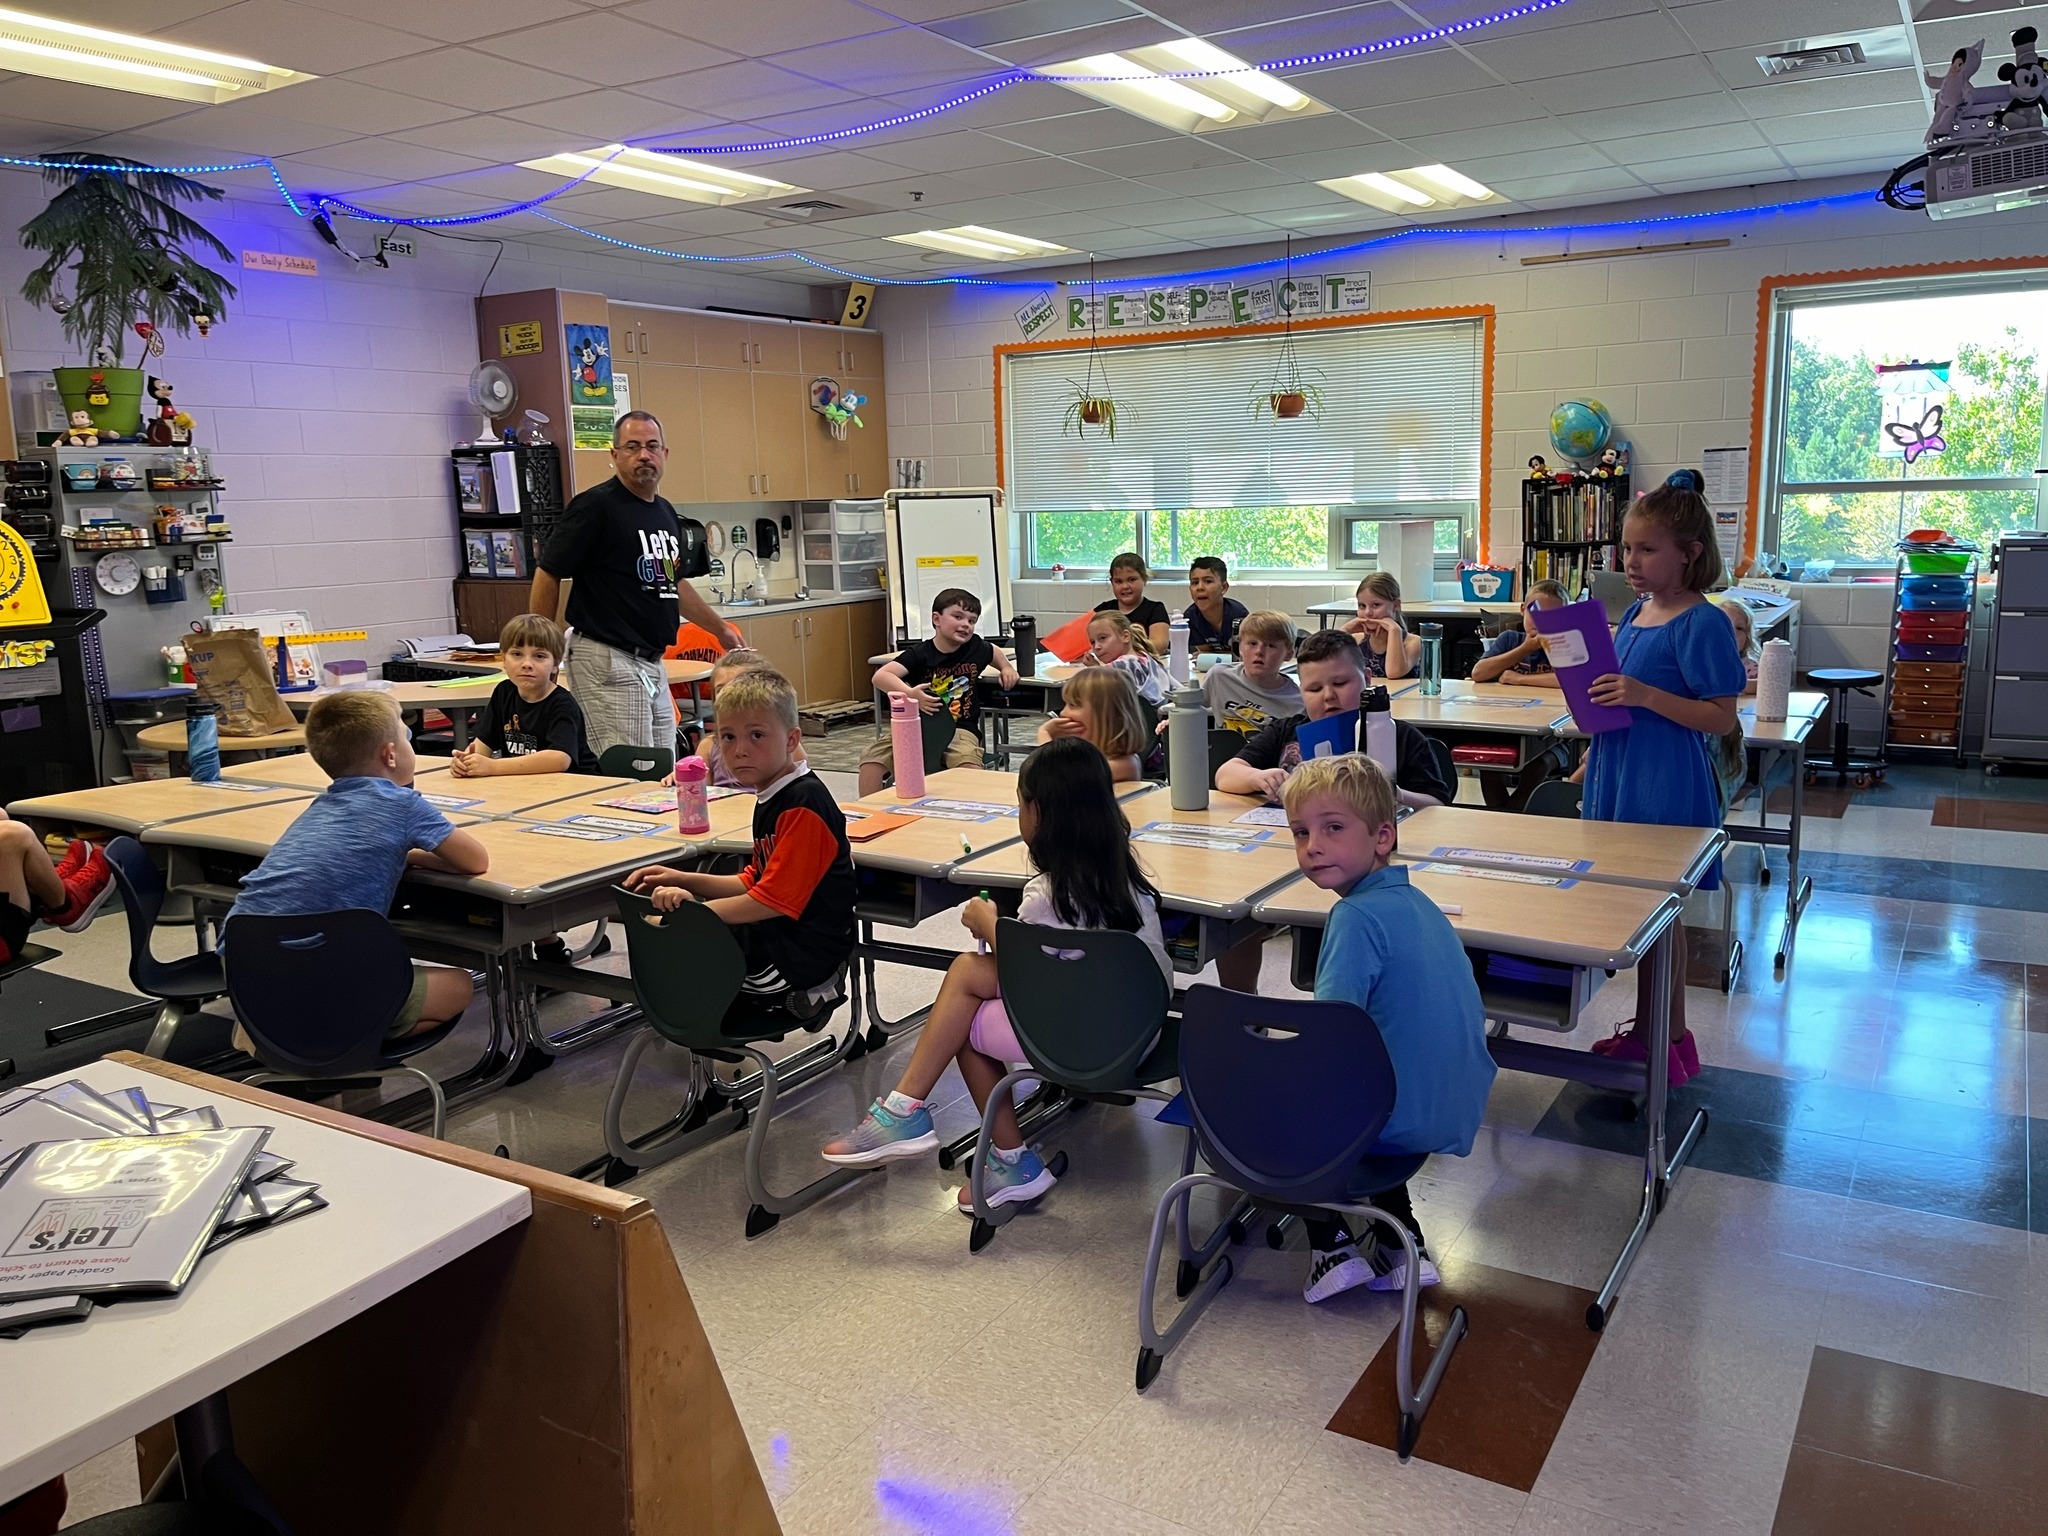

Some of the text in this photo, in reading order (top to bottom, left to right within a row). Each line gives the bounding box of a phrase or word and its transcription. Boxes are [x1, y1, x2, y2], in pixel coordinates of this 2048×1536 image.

[381, 238, 411, 254] East
[244, 252, 316, 271] Our Daily Schedule
[1346, 297, 1366, 306] Equal
[849, 295, 867, 320] 3
[1020, 296, 1047, 325] All About
[1023, 304, 1056, 336] RESPECT
[515, 343, 540, 351] SOCCER
[1, 540, 9, 551] 2
[638, 529, 680, 561] Let's
[9, 555, 17, 565] 3
[9, 571, 17, 580] 4
[0, 581, 8, 592] 5
[1245, 700, 1263, 709] THE
[24, 1209, 146, 1238] GLOW
[28, 1226, 119, 1252] Let's
[45, 1258, 89, 1268] Return
[91, 1256, 132, 1264] Please
[28, 1263, 44, 1271] to
[68, 1267, 115, 1276] Graded
[29, 1270, 66, 1278] Paper
